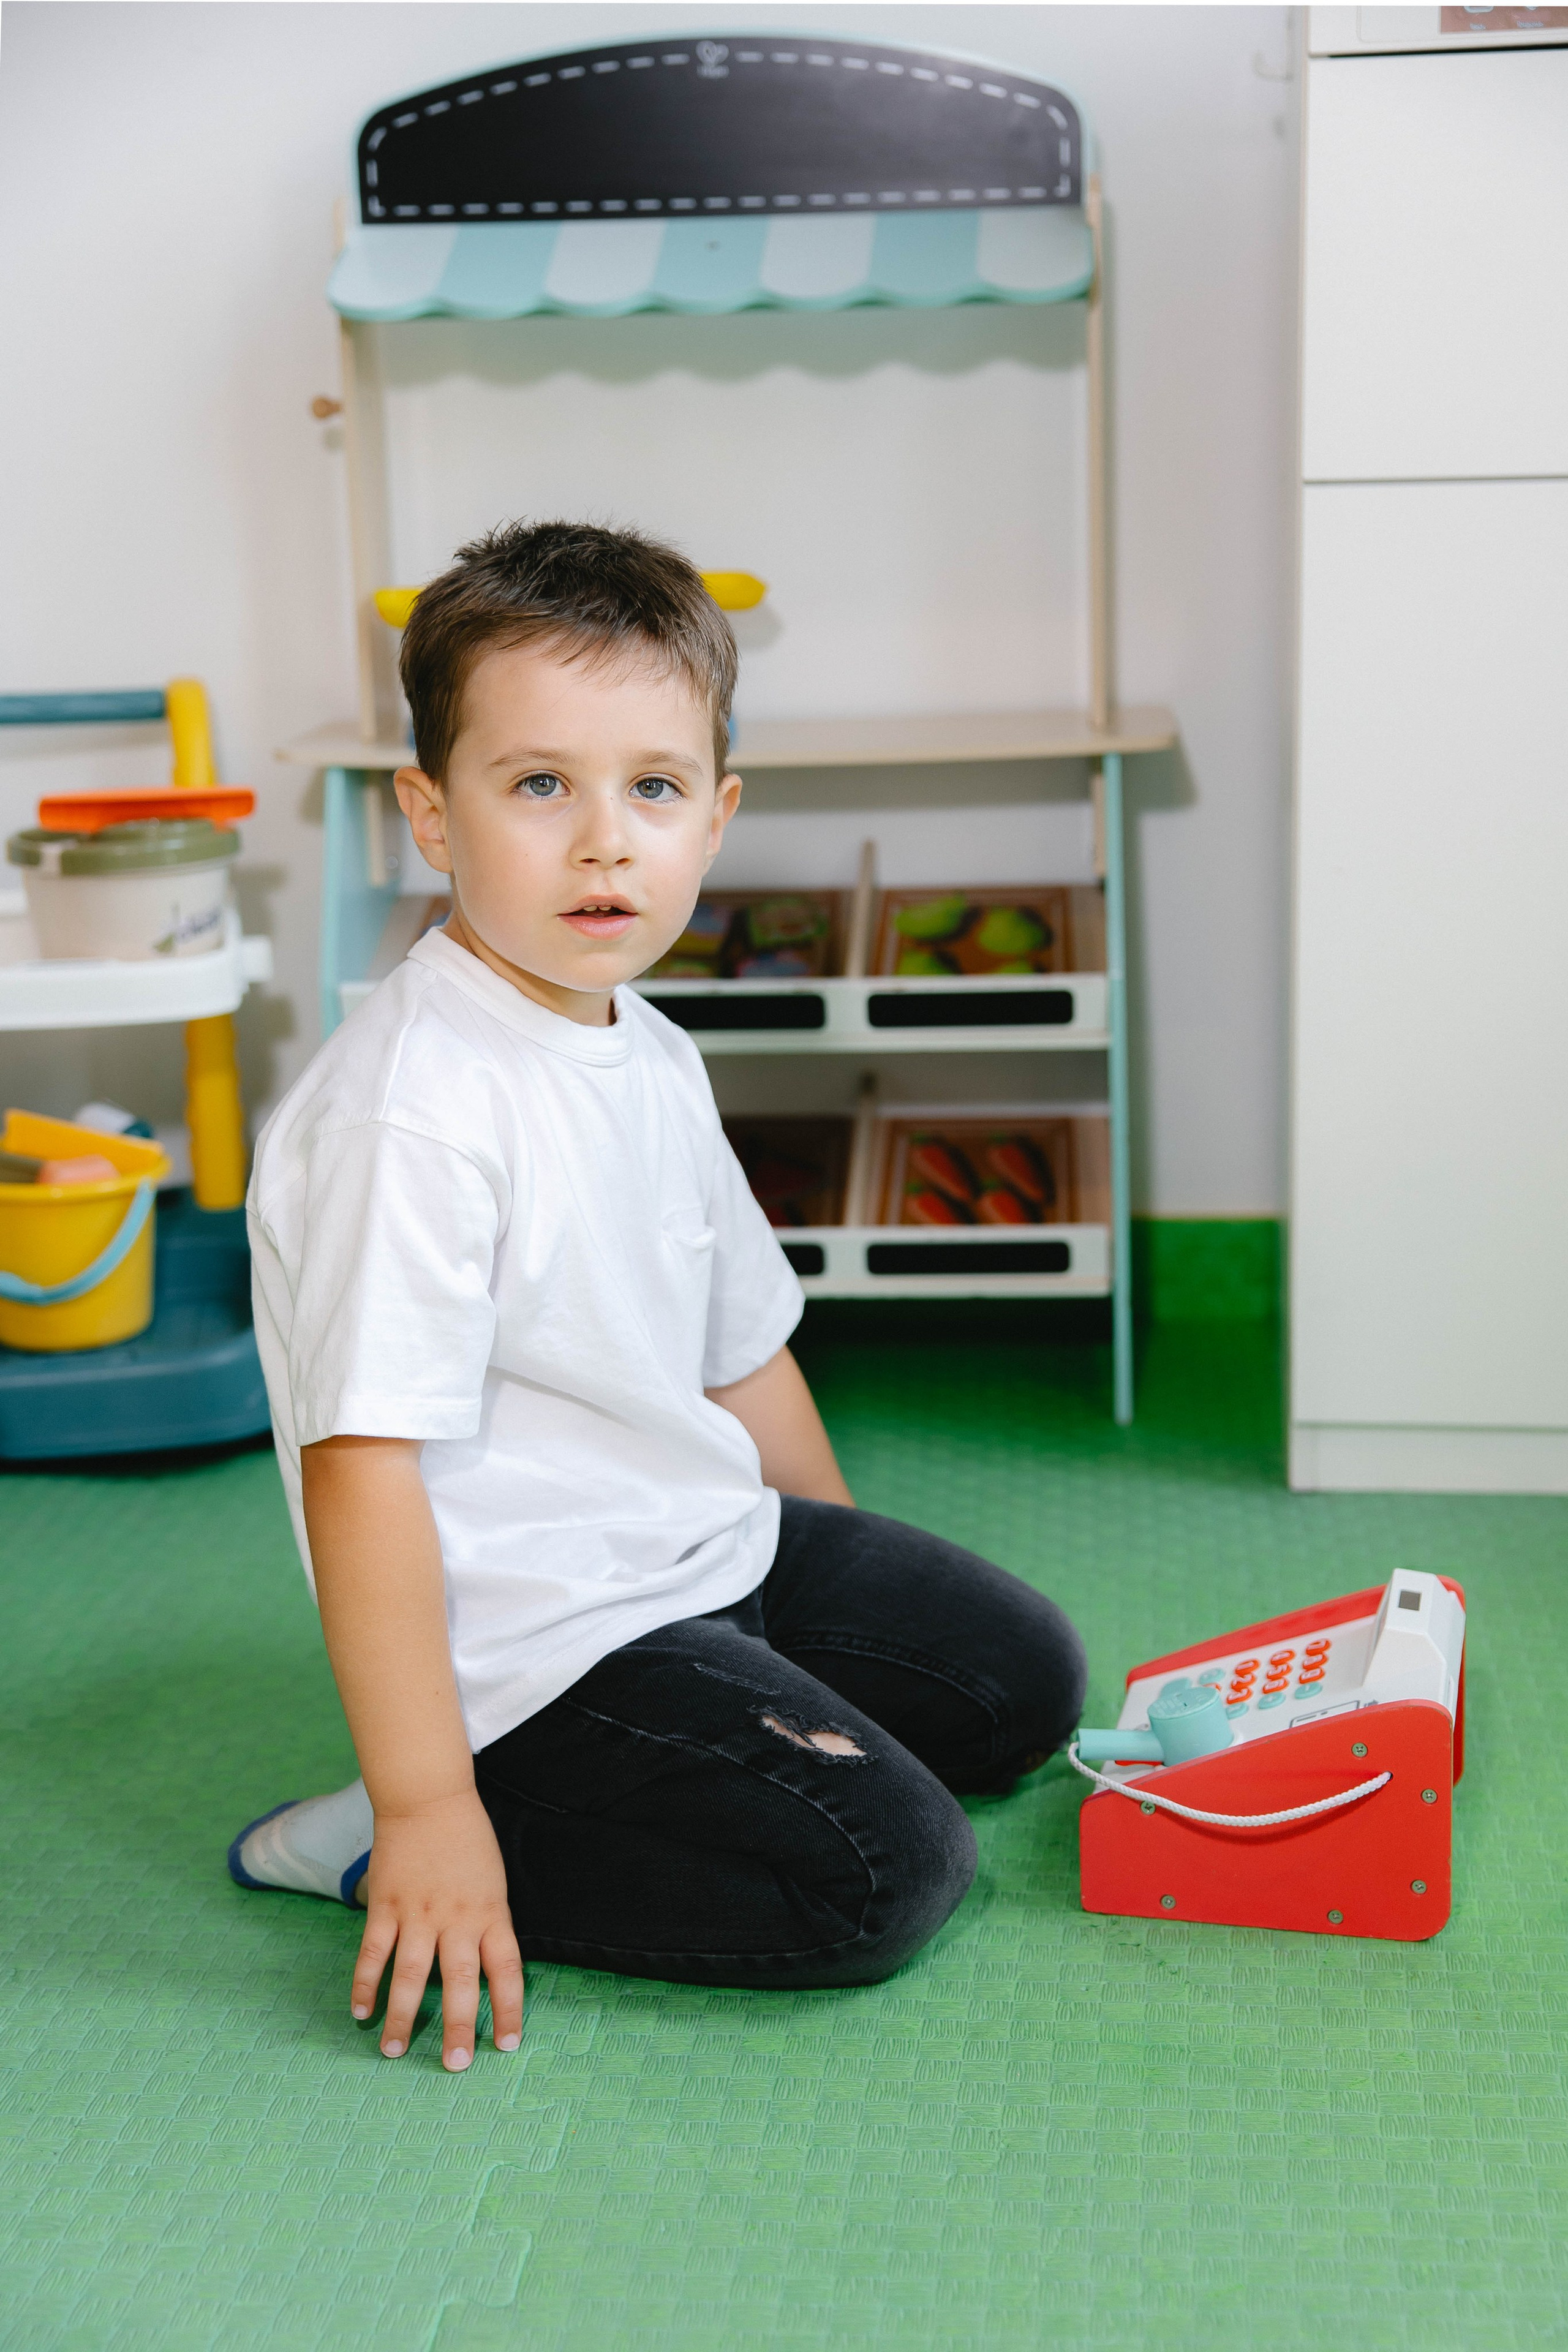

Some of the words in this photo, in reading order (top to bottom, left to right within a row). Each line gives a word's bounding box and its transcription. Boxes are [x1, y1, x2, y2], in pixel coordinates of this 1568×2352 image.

[1306, 1640, 1326, 1650] 7
[1235, 1660, 1255, 1670] 1
[1268, 1663, 1288, 1676] 5
[1232, 1673, 1253, 1686] 2
[1301, 1667, 1321, 1680] 9
[1227, 1688, 1248, 1701] 3
